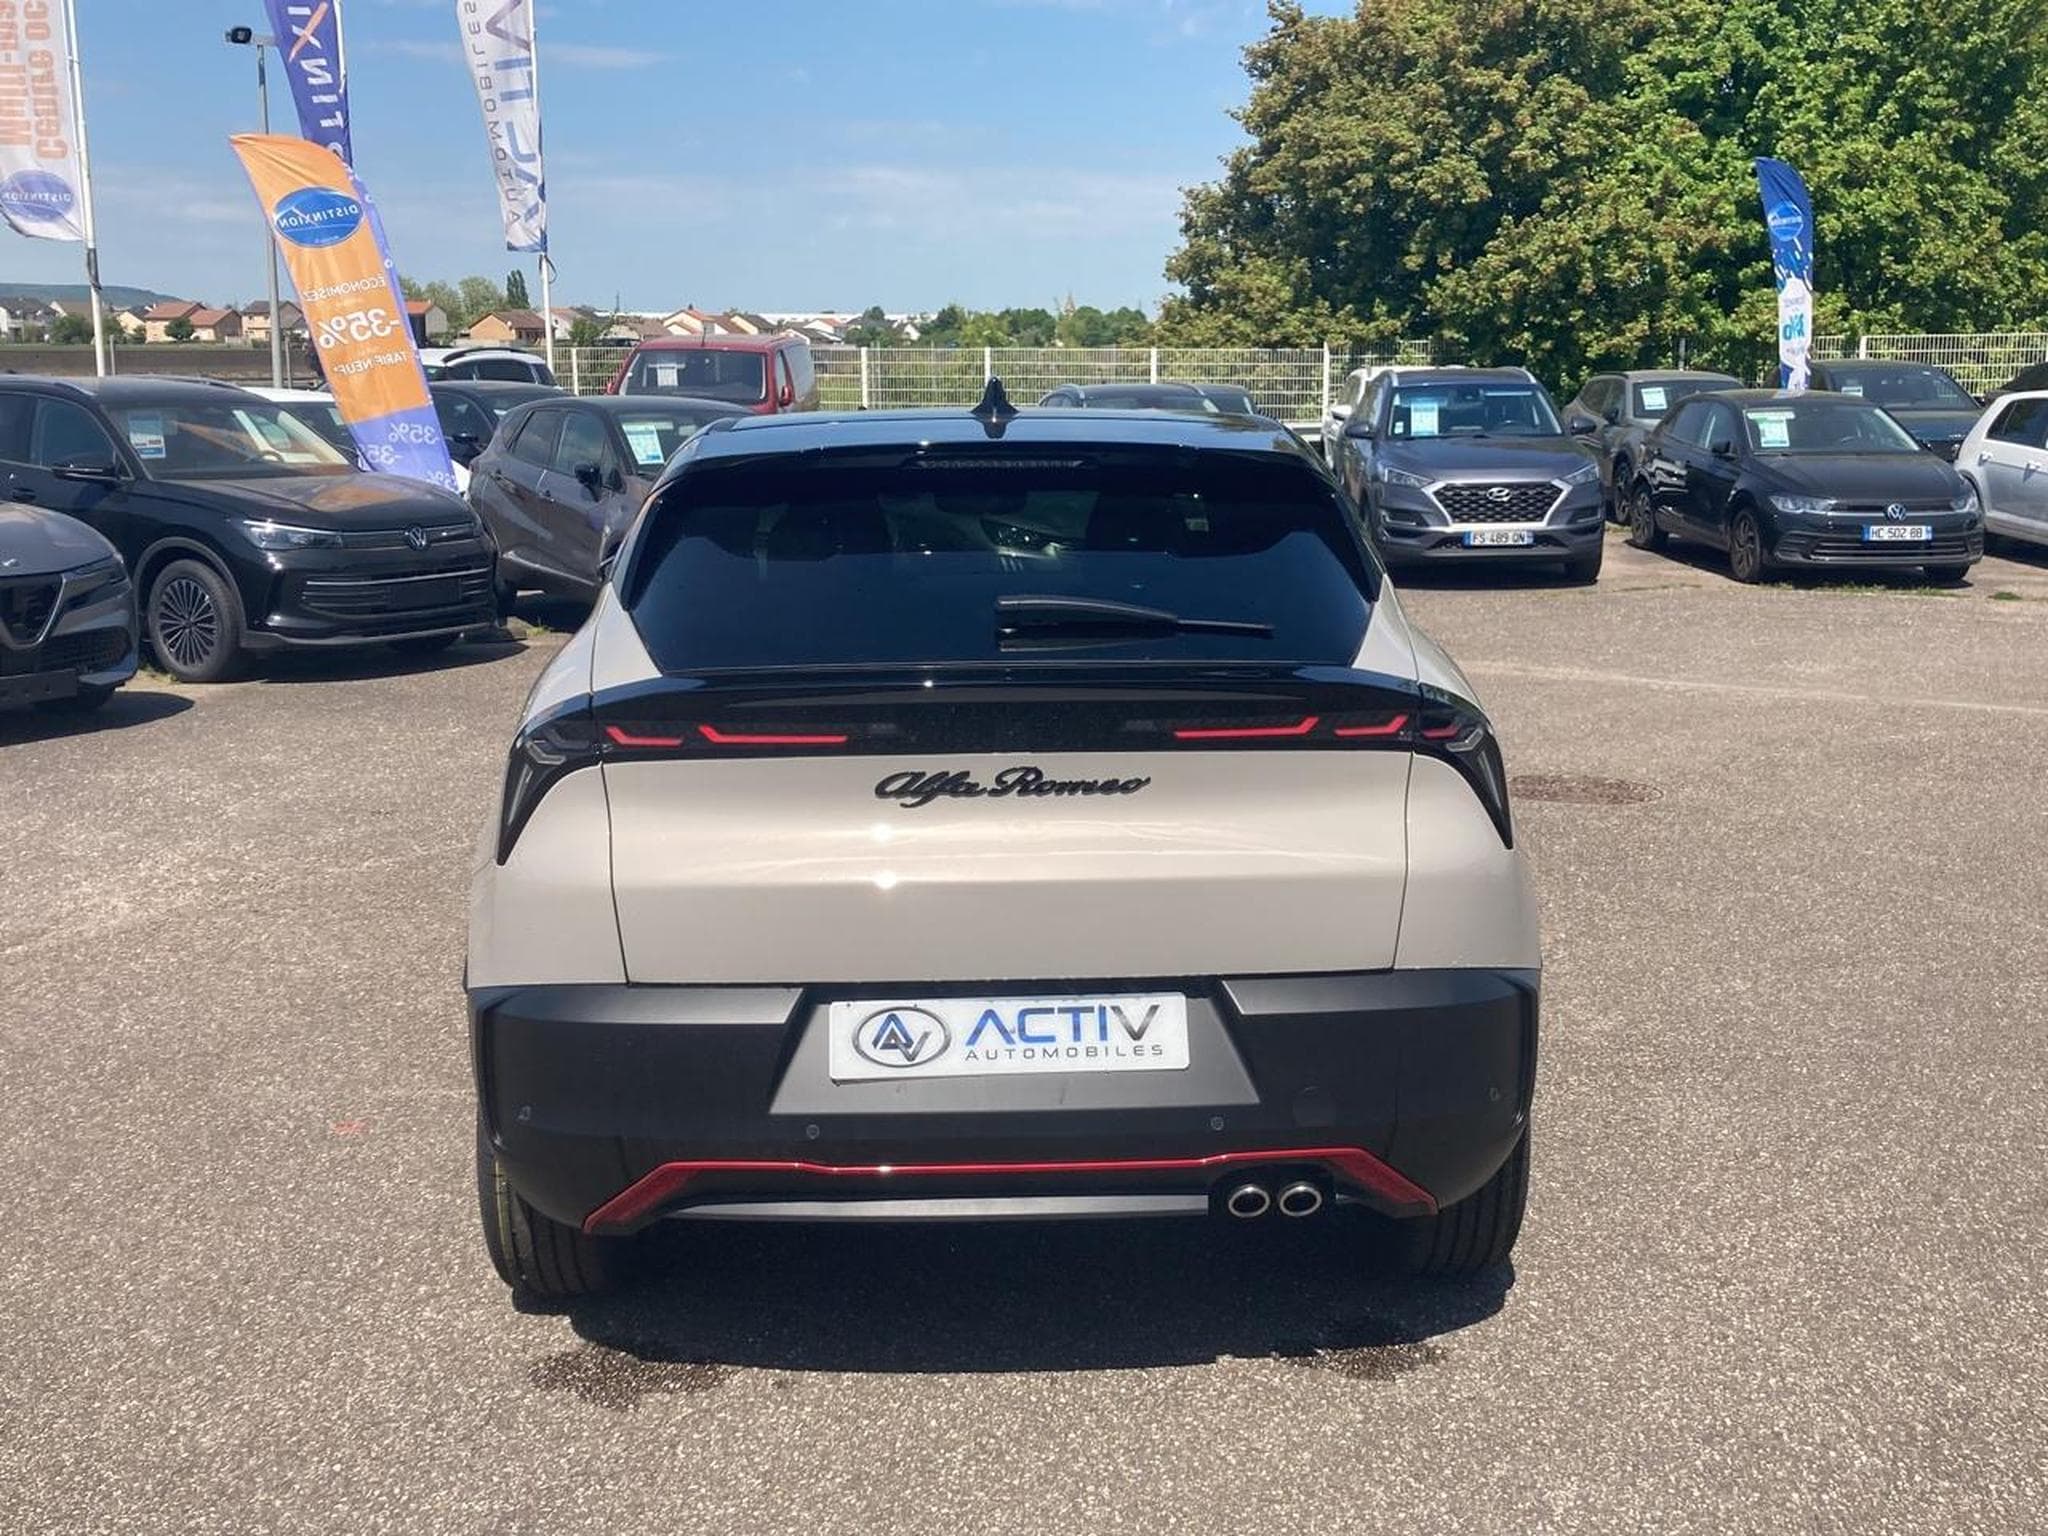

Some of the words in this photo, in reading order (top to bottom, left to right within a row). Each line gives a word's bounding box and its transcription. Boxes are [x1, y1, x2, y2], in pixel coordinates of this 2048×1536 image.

[1887, 527, 1907, 539] 502
[875, 771, 988, 808] Alfa
[988, 766, 1151, 797] Romeo
[965, 1004, 1160, 1046] ACTIV
[965, 1044, 1163, 1062] AUTOMOBILES
